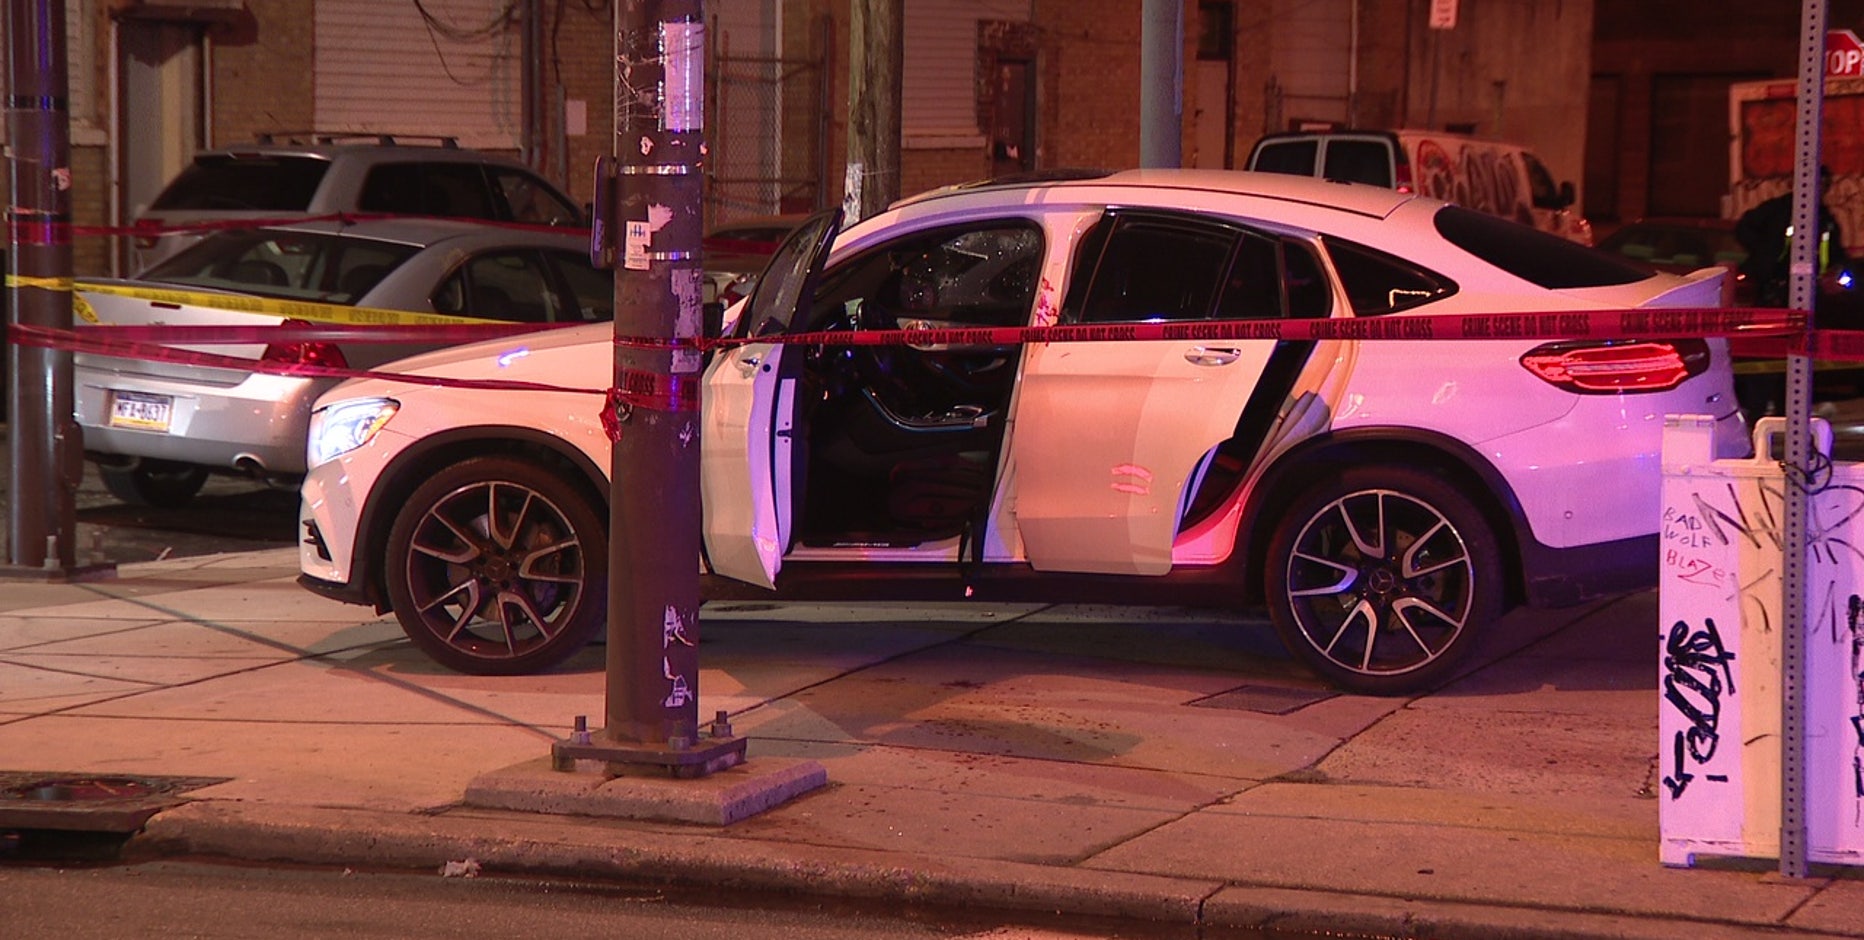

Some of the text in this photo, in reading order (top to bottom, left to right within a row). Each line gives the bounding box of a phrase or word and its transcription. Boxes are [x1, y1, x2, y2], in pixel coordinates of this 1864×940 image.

[1827, 49, 1860, 74] OP
[1162, 322, 1281, 339] CRIME SCENE DO NOT CROSS
[1310, 318, 1433, 339] CRIME SCENE DO NOT CROSS
[1461, 313, 1591, 337] CRIME SCENE DO NOT CROSS
[1620, 312, 1650, 333] CRIME
[1653, 312, 1683, 333] SCENE
[1664, 507, 1702, 530] BAD
[1664, 525, 1711, 548] WOLF
